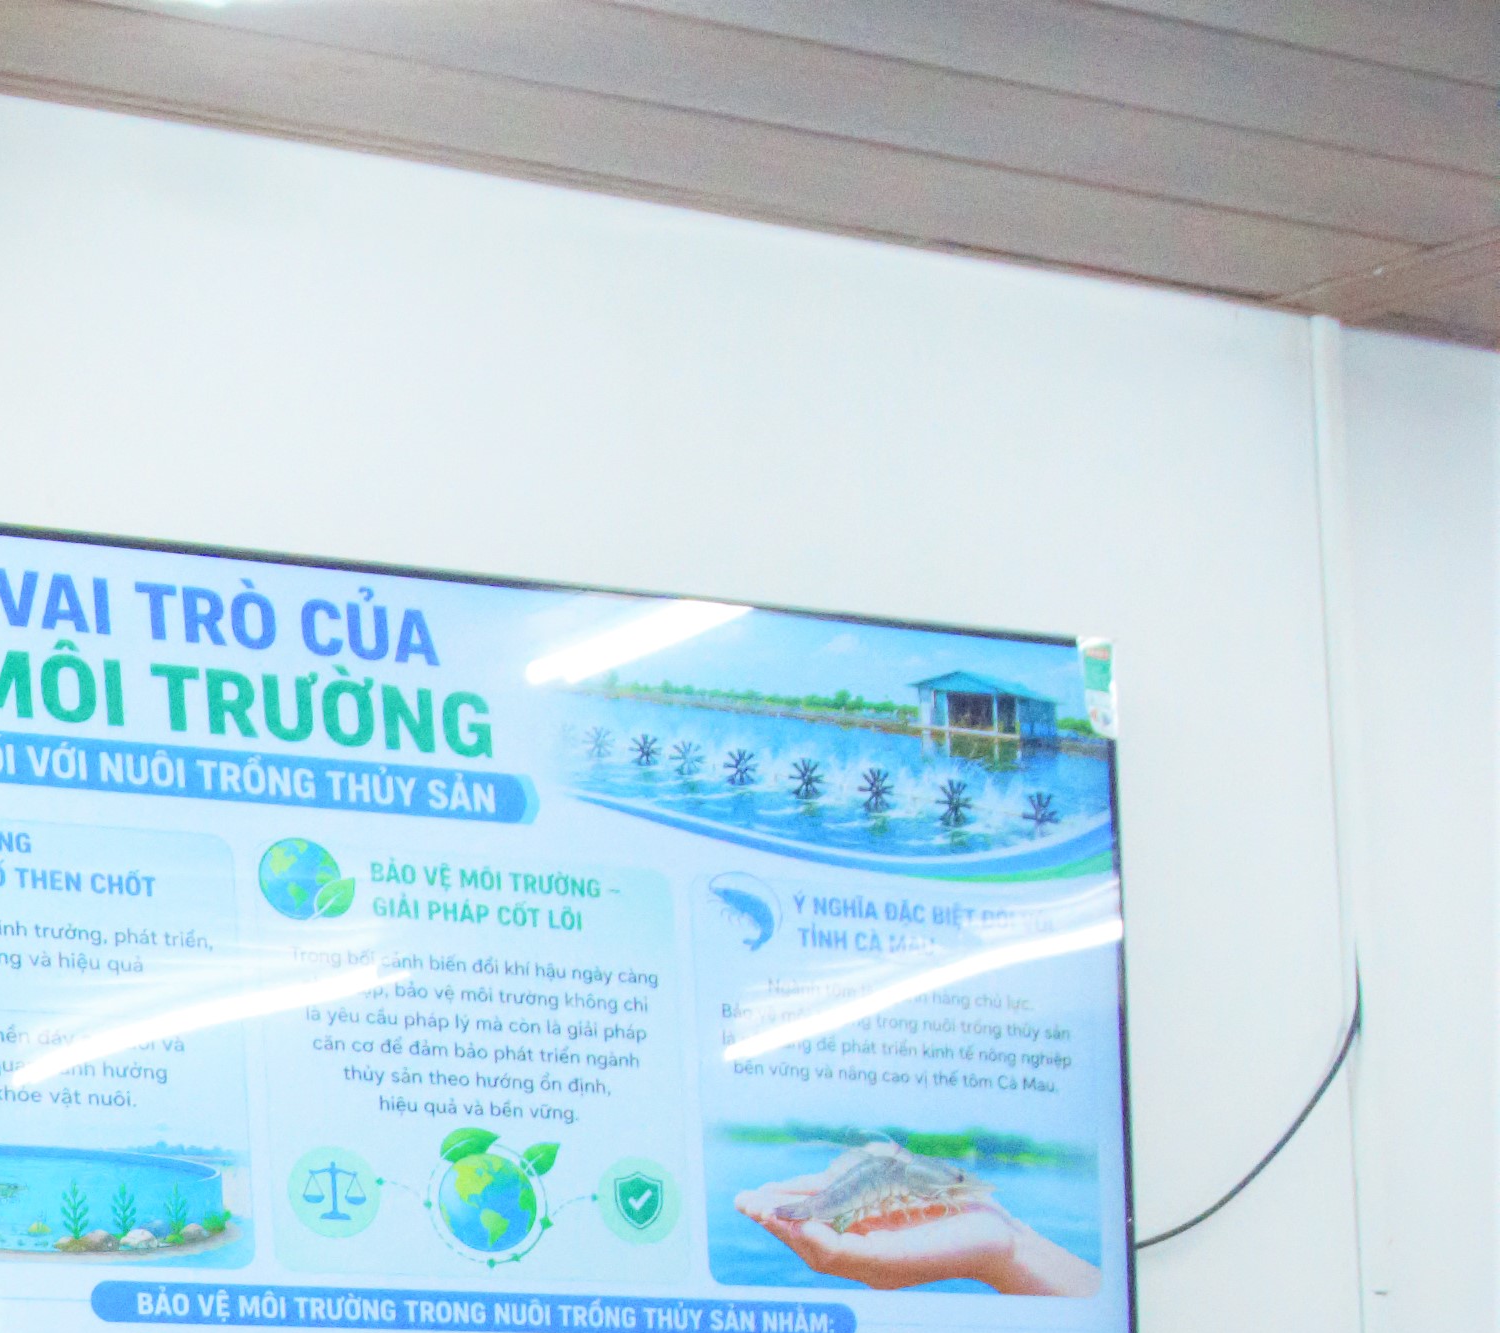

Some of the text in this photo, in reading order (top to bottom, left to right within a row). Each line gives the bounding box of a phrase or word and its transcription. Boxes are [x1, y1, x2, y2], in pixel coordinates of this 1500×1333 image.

[134, 578, 278, 651] TRÒ
[300, 586, 441, 667] CỦA
[149, 663, 493, 759] TRƯỜNG
[26, 741, 89, 782] VỚI
[99, 749, 187, 789] NUÔI
[196, 754, 317, 800] TRỒNG
[325, 764, 417, 807] THỦY
[427, 771, 497, 814] SẢN
[13, 866, 83, 893] THEN
[89, 869, 157, 899] CHỐT
[369, 856, 418, 886] BẢO
[422, 862, 452, 893] VỆ
[458, 865, 503, 892] MÔI
[508, 871, 602, 899] TRƯỜNG
[371, 892, 584, 932] GIẢI PHÁP CỐT LÕI
[33, 922, 109, 948] trưởng,
[113, 927, 158, 948] phát
[163, 929, 214, 953] triển,
[28, 954, 53, 969] và
[57, 951, 102, 974] hiệu
[106, 959, 145, 977] quả
[136, 1285, 191, 1318] BẢO
[197, 1288, 231, 1323] VỆ
[238, 1290, 288, 1320] MÔI
[293, 1292, 397, 1322] TRƯỜNG
[403, 1299, 487, 1325] TRONG
[493, 1298, 552, 1327] NUÔI
[557, 1295, 637, 1329] TRỒNG
[642, 1301, 704, 1331] THỦY
[710, 1303, 757, 1333] SẢN
